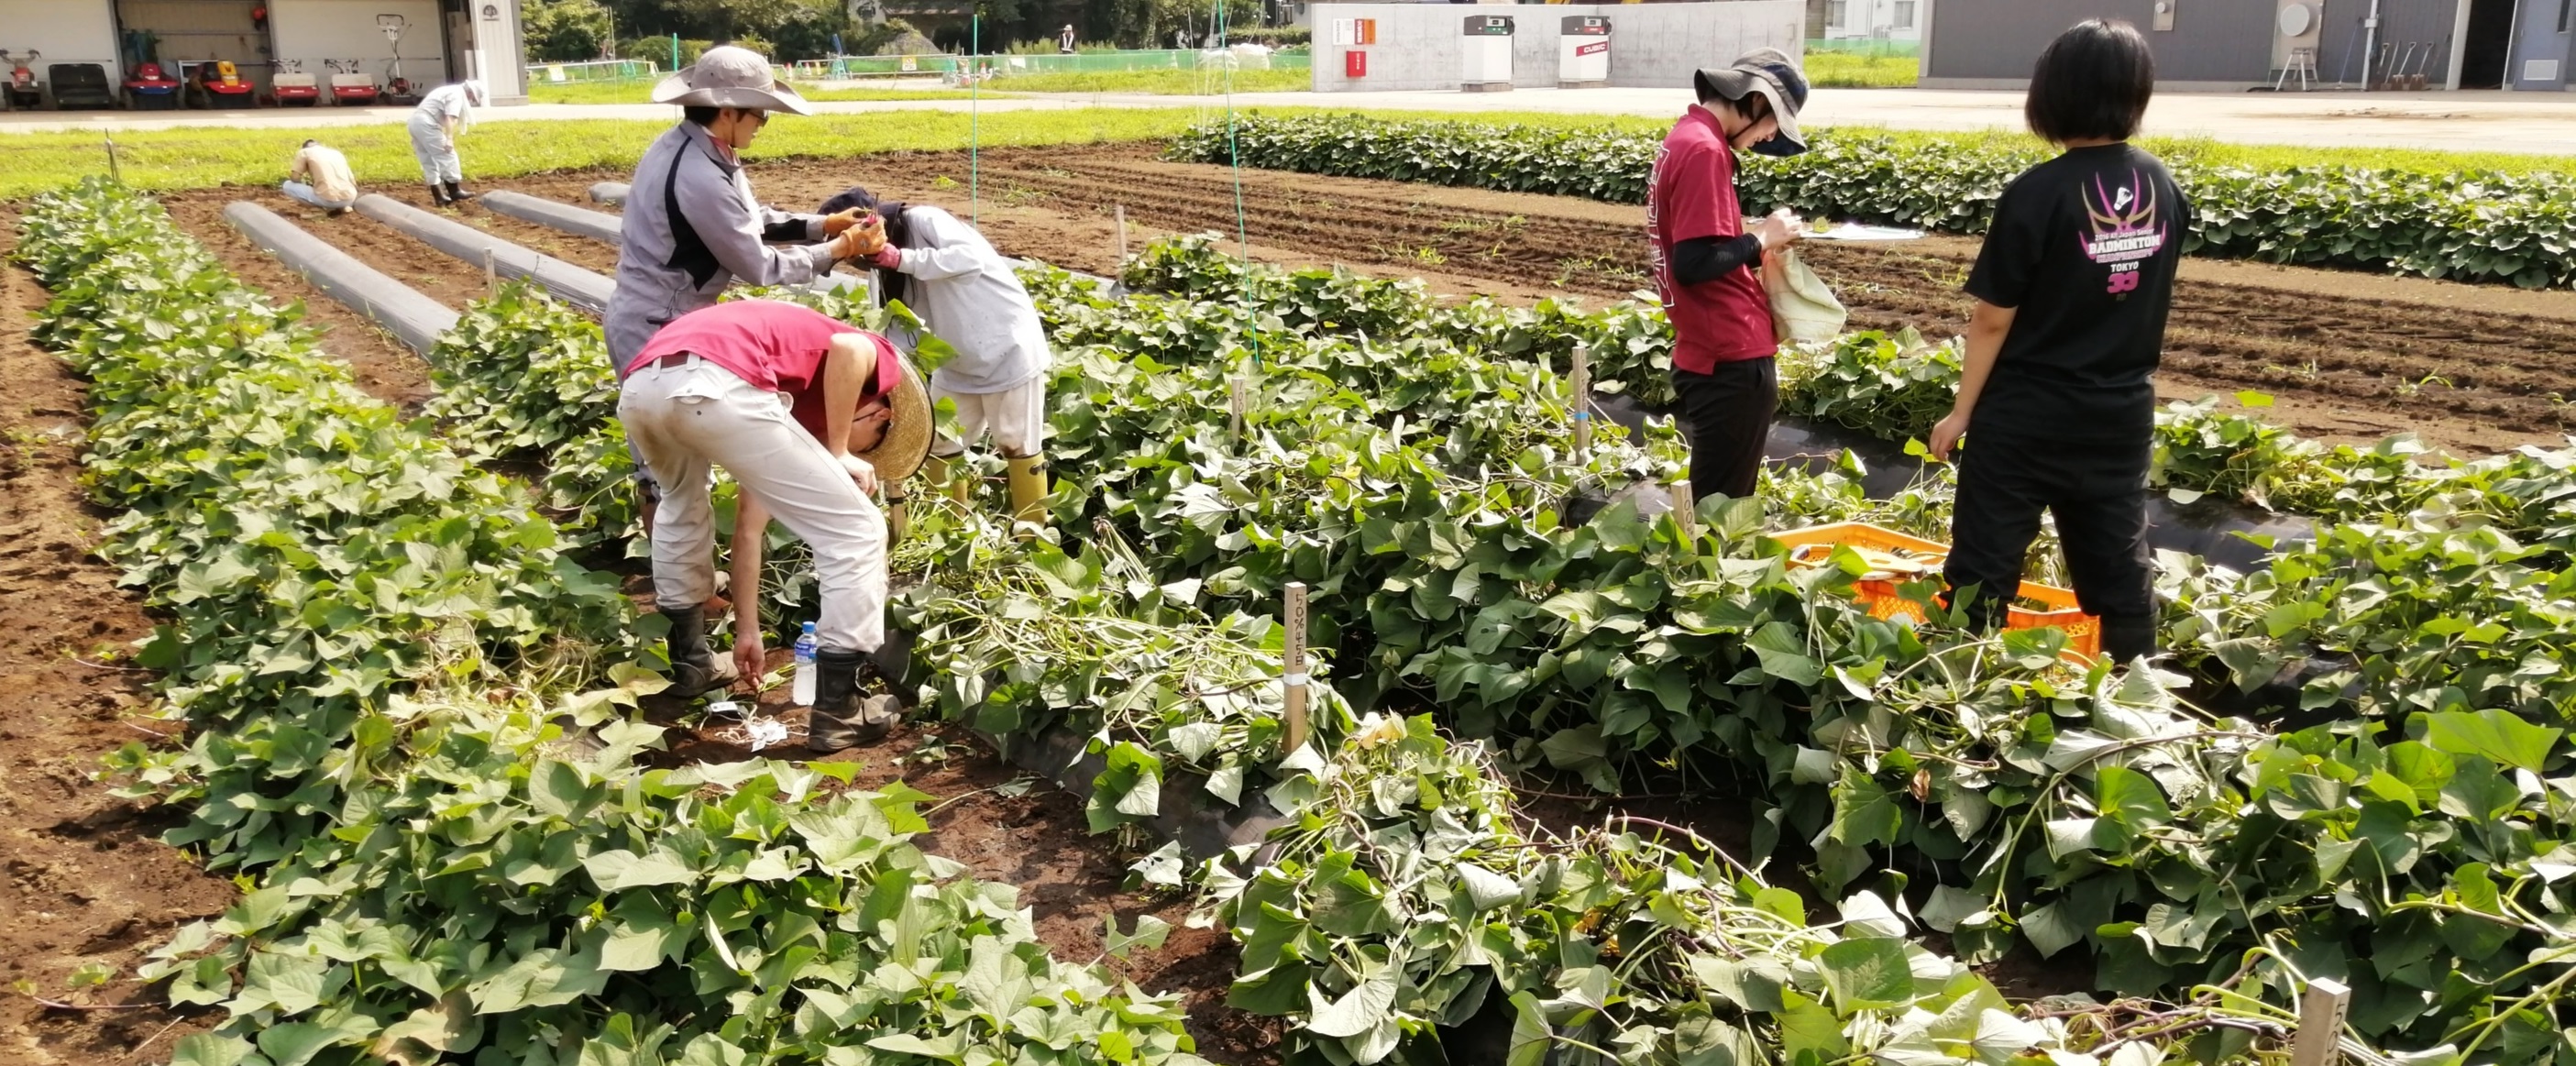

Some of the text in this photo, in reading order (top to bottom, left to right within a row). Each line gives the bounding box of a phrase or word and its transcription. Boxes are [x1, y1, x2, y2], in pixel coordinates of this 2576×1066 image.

[1583, 43, 1605, 53] CUBIC
[2095, 233, 2108, 241] 2016
[2119, 231, 2136, 239] Japan
[2137, 228, 2154, 236] Senior
[2088, 235, 2161, 254] BADMINTON
[2110, 261, 2139, 272] TOKYO
[1294, 593, 1305, 666] 50%45日
